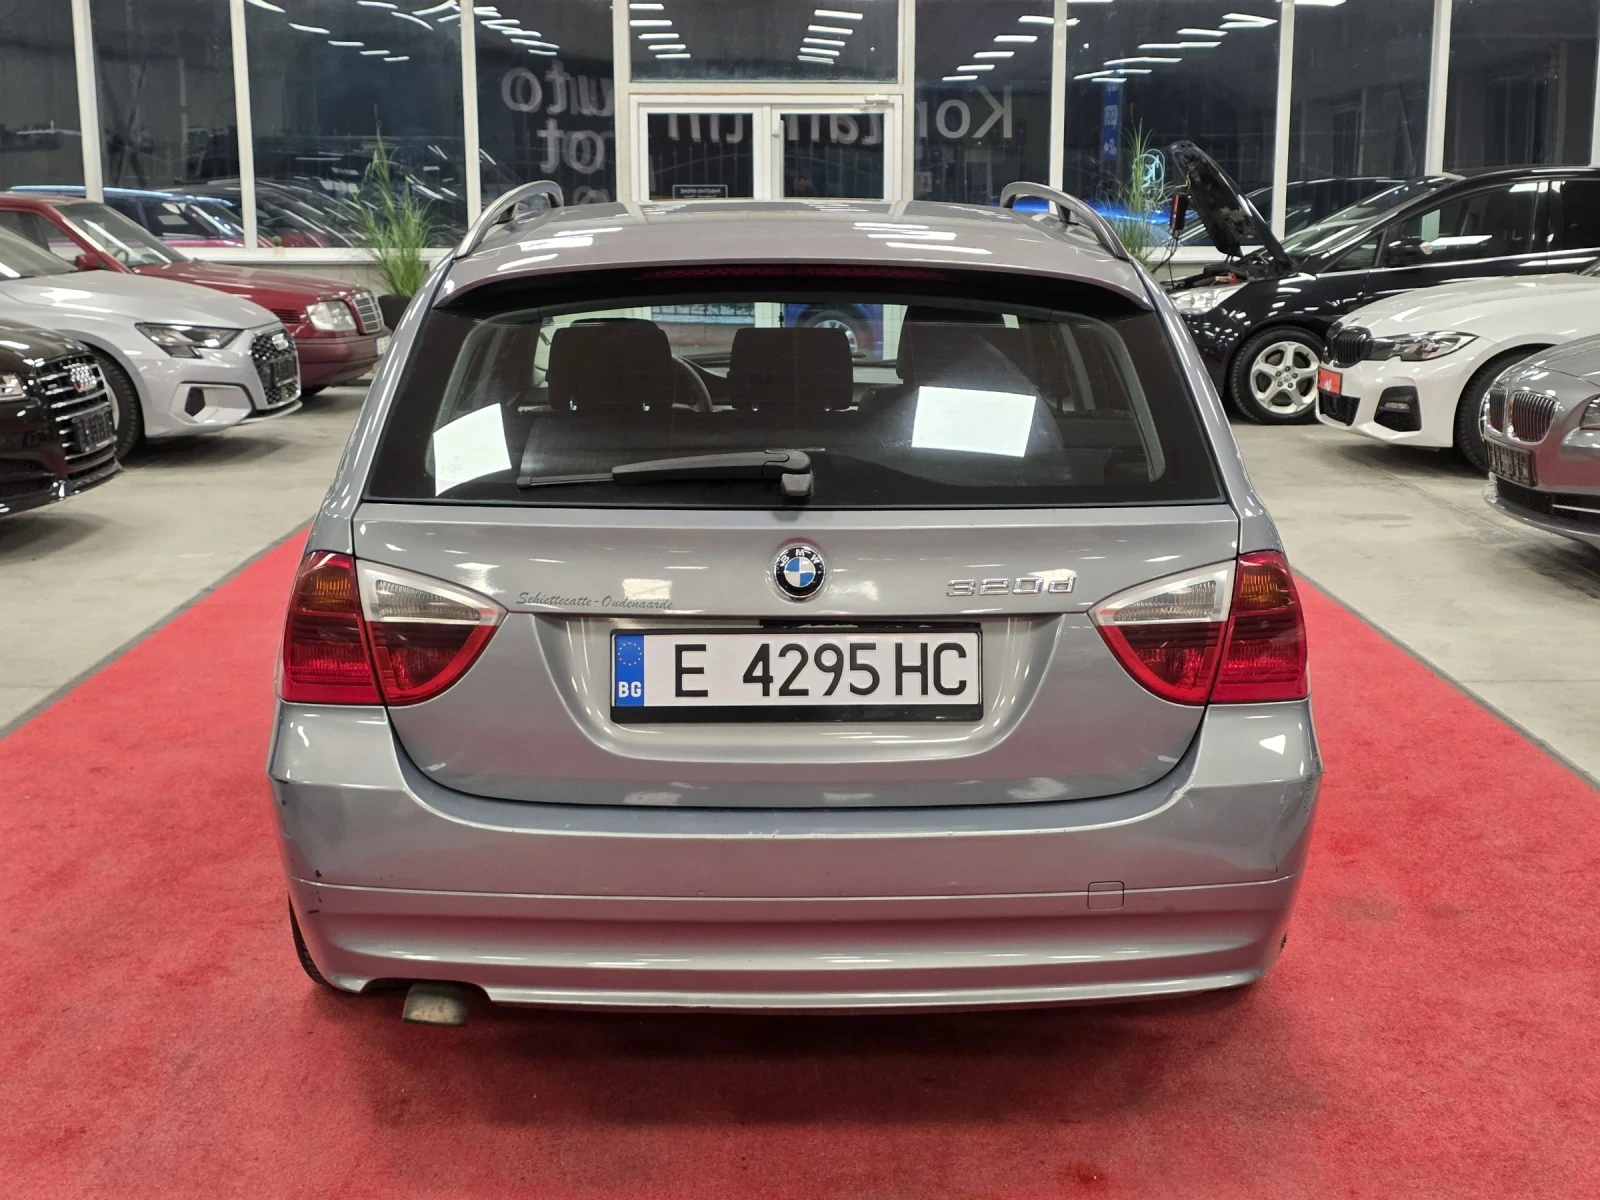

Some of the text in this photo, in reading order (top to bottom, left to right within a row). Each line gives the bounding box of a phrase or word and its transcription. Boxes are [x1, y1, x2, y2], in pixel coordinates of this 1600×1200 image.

[780, 549, 821, 566] BMW
[946, 576, 1076, 597] 320d
[675, 642, 967, 697] E 4295 HC
[618, 681, 642, 698] BG
